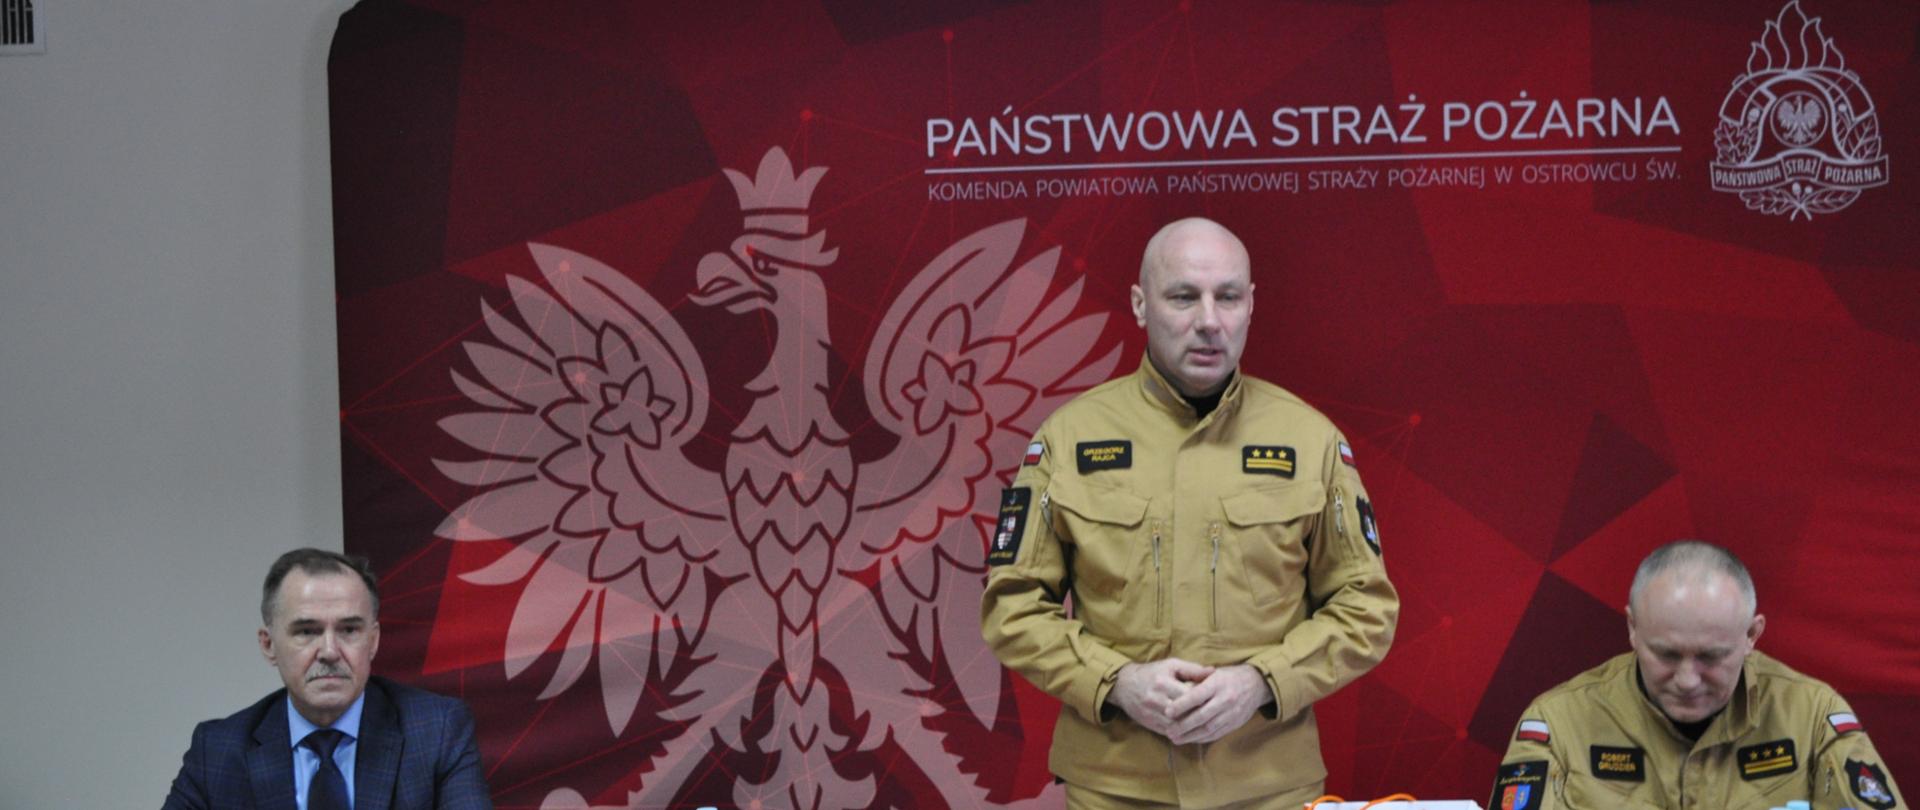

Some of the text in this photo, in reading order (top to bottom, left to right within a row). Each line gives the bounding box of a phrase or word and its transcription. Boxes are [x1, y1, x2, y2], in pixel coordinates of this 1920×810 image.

[926, 91, 1680, 157] PAŃSTWOWA STRAŻ POŻARNA
[928, 157, 1682, 201] KOMENDA POWIATOWA PAŃSTWOWEJ STRAŻY POŻARNEJ W OSTROWCU ŚW.
